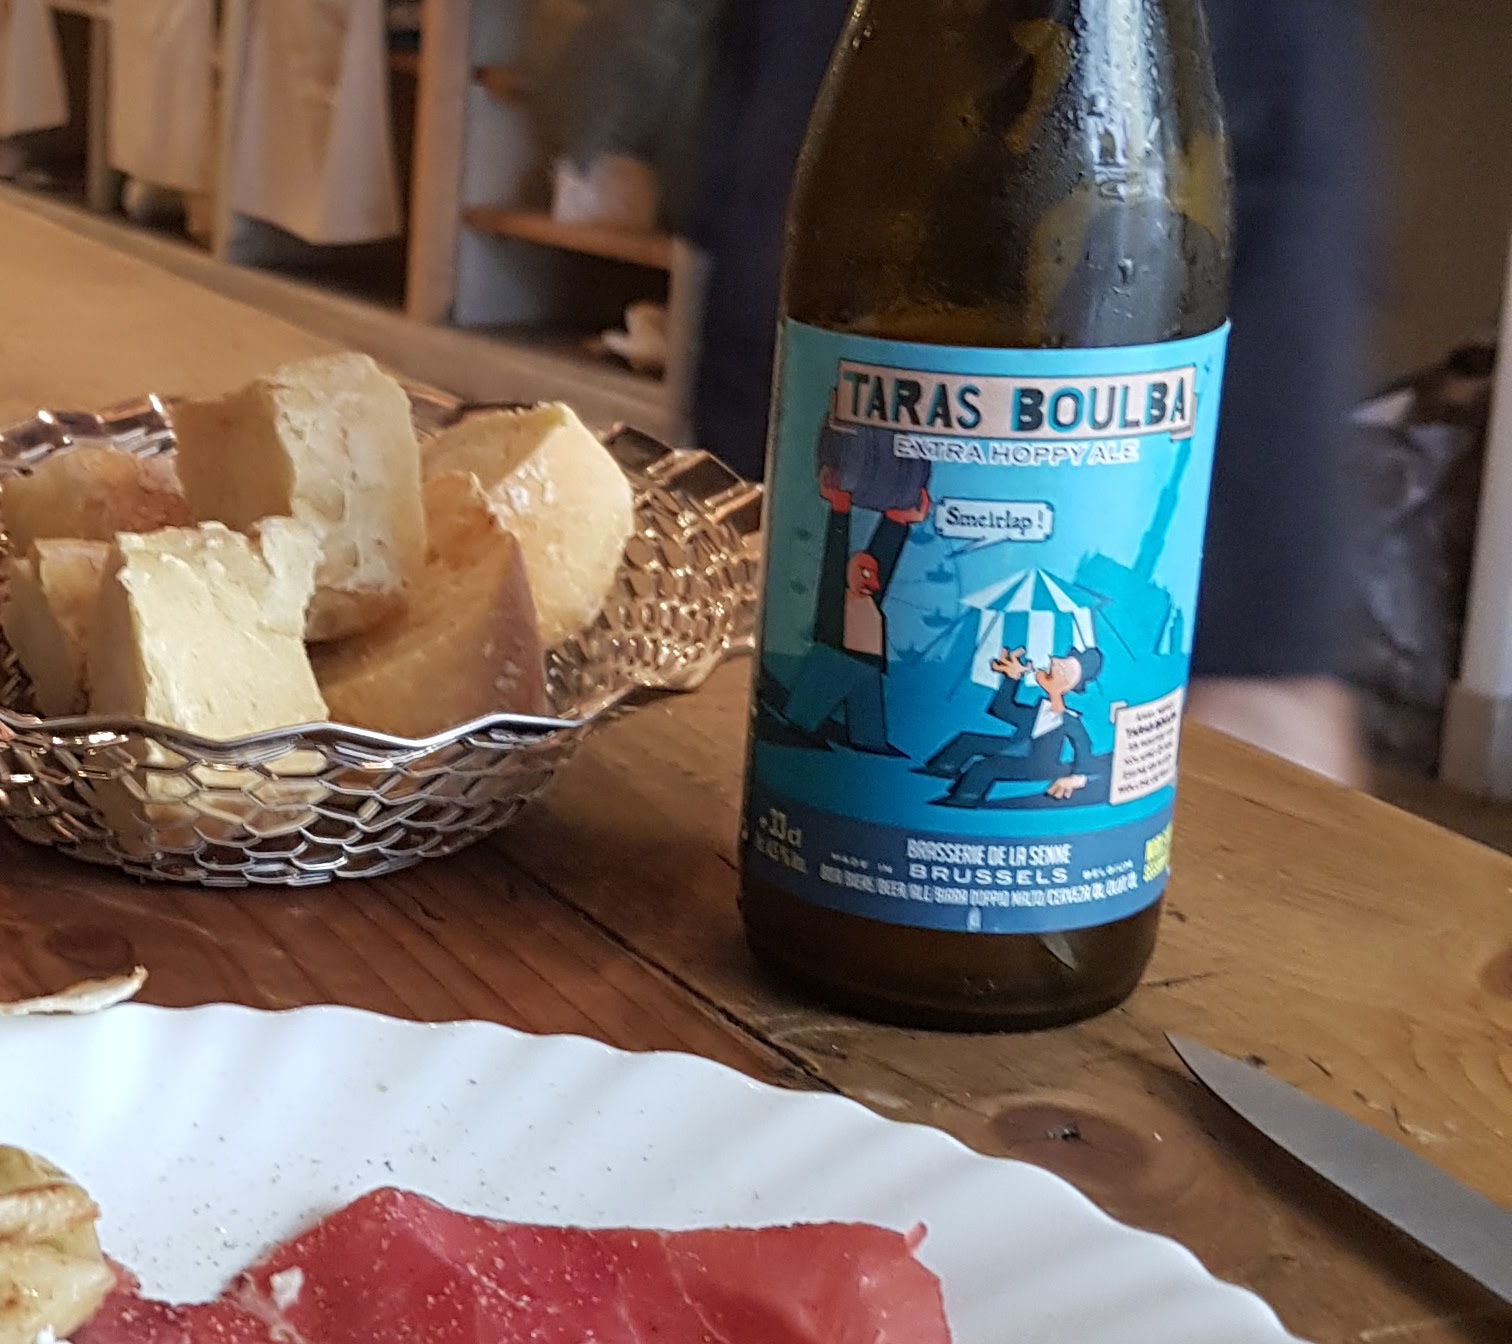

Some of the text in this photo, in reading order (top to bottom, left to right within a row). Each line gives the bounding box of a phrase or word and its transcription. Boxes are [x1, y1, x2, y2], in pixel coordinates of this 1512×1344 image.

[842, 370, 1186, 433] TARAS BOULBA
[893, 434, 1140, 466] EXTRA HOPPY ALE
[907, 837, 986, 866] BRASSERIE
[987, 845, 1007, 866] DE
[1009, 845, 1027, 866] LA
[908, 862, 1069, 887] BRUSSELS
